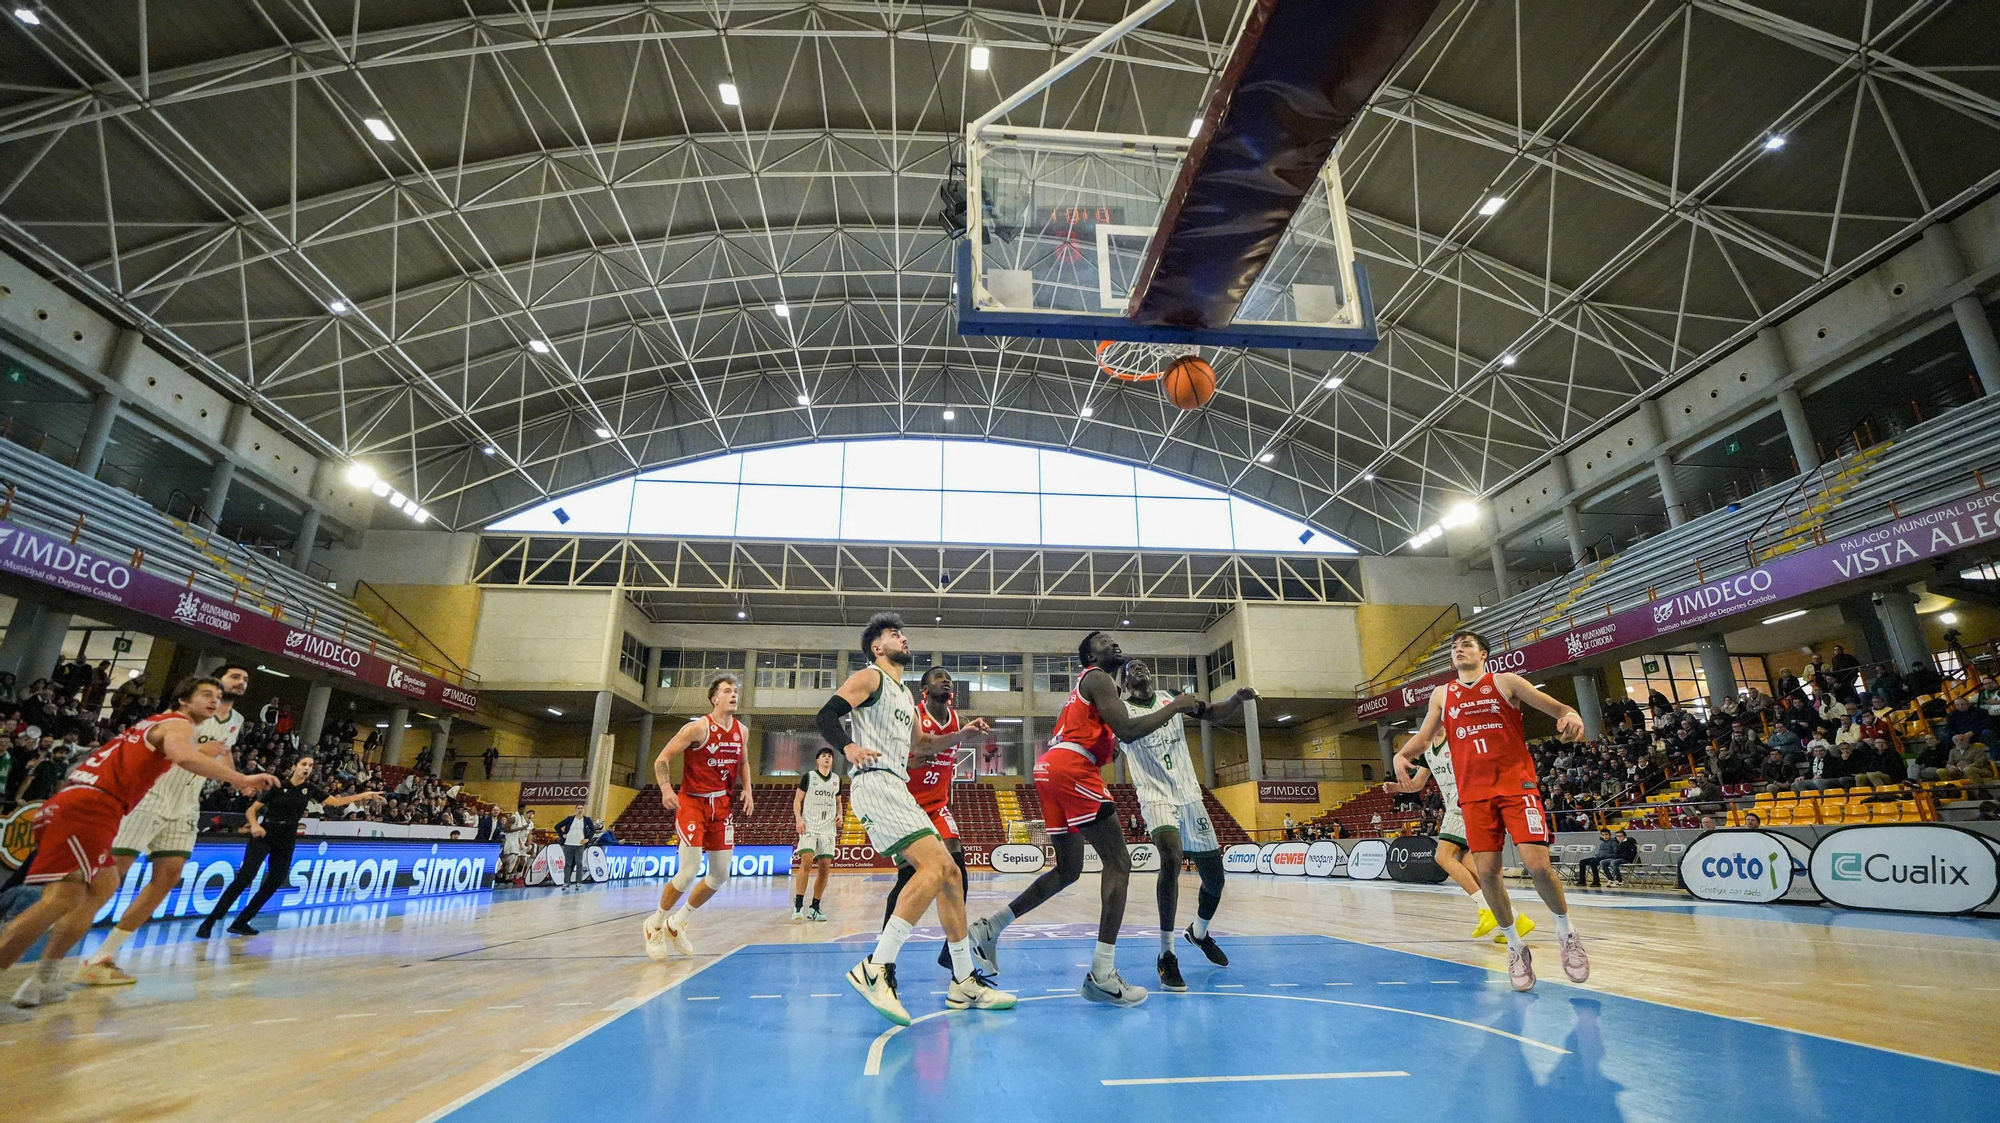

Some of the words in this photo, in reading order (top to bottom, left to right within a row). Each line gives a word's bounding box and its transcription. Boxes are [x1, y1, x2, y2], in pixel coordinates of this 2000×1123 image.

[1840, 529, 1890, 552] PALACIO
[1892, 507, 1964, 536] MUNICIPAL
[11, 531, 130, 589] IMDECO
[1832, 538, 1919, 578] VISTA
[3, 559, 45, 578] Municipal
[46, 573, 57, 582] de
[57, 576, 92, 593] Deportes
[1676, 569, 1772, 616] IMDECO
[197, 612, 206, 623] DE
[200, 602, 241, 623] AYUNTAMIENTO
[1657, 622, 1680, 633] Instituto
[1680, 613, 1709, 627] Municipal
[1717, 602, 1747, 615] Deportes
[1582, 623, 1617, 641] AYUNTAMIENTO
[119, 640, 128, 651] D
[304, 634, 361, 668] IMDECO
[1583, 641, 1591, 650] DE
[1648, 663, 1656, 672] G
[450, 688, 477, 707] IMDECO
[1363, 696, 1388, 713] IMDECO
[1466, 722, 1503, 732] E.Leclerc
[1473, 738, 1488, 754] 11
[1163, 753, 1173, 771] 8
[923, 770, 940, 785] 25
[537, 786, 589, 797] IMDECO
[1273, 786, 1317, 796] IMDECO
[1522, 794, 1538, 808] 11
[833, 846, 875, 860] DECO
[1002, 853, 1040, 866] Sepisur
[1132, 852, 1153, 862] CSIF
[1227, 851, 1256, 864] simon
[1274, 852, 1307, 865] GEWIS
[282, 841, 399, 907] simon
[408, 843, 486, 896] simon
[1702, 853, 1763, 880] coto
[1864, 853, 1970, 886] Cualix
